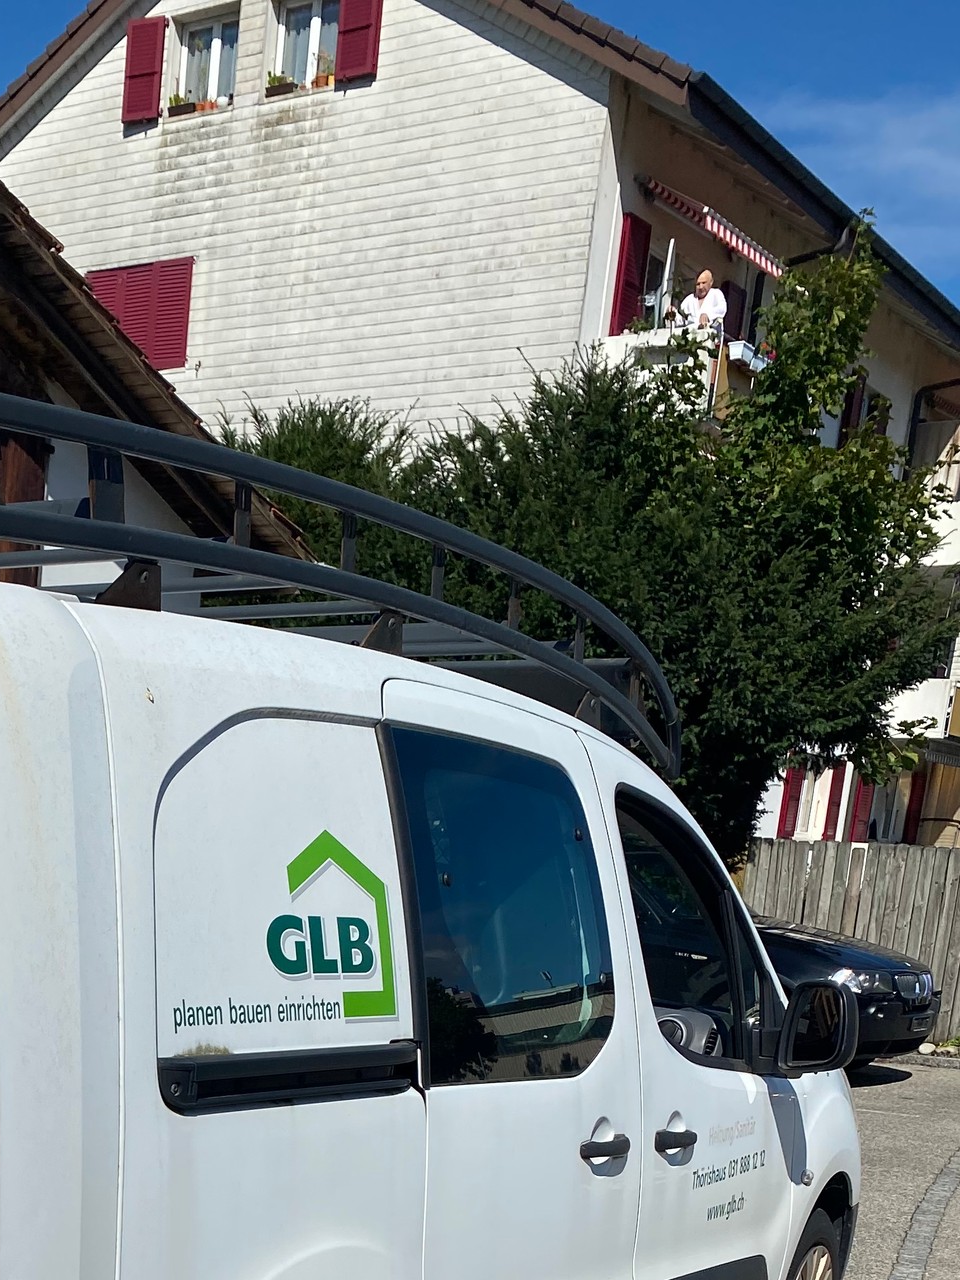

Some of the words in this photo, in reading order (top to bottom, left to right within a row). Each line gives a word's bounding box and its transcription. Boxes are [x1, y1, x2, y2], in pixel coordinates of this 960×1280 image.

[266, 914, 376, 981] GLB
[173, 999, 223, 1034] planen
[228, 997, 272, 1024] bauen
[277, 995, 341, 1022] einrichten
[692, 1164, 727, 1190] Thörishaus
[727, 1158, 739, 1179] 031
[751, 1151, 759, 1170] 12
[759, 1149, 766, 1168] 12
[706, 1191, 745, 1222] www.glb.ch
